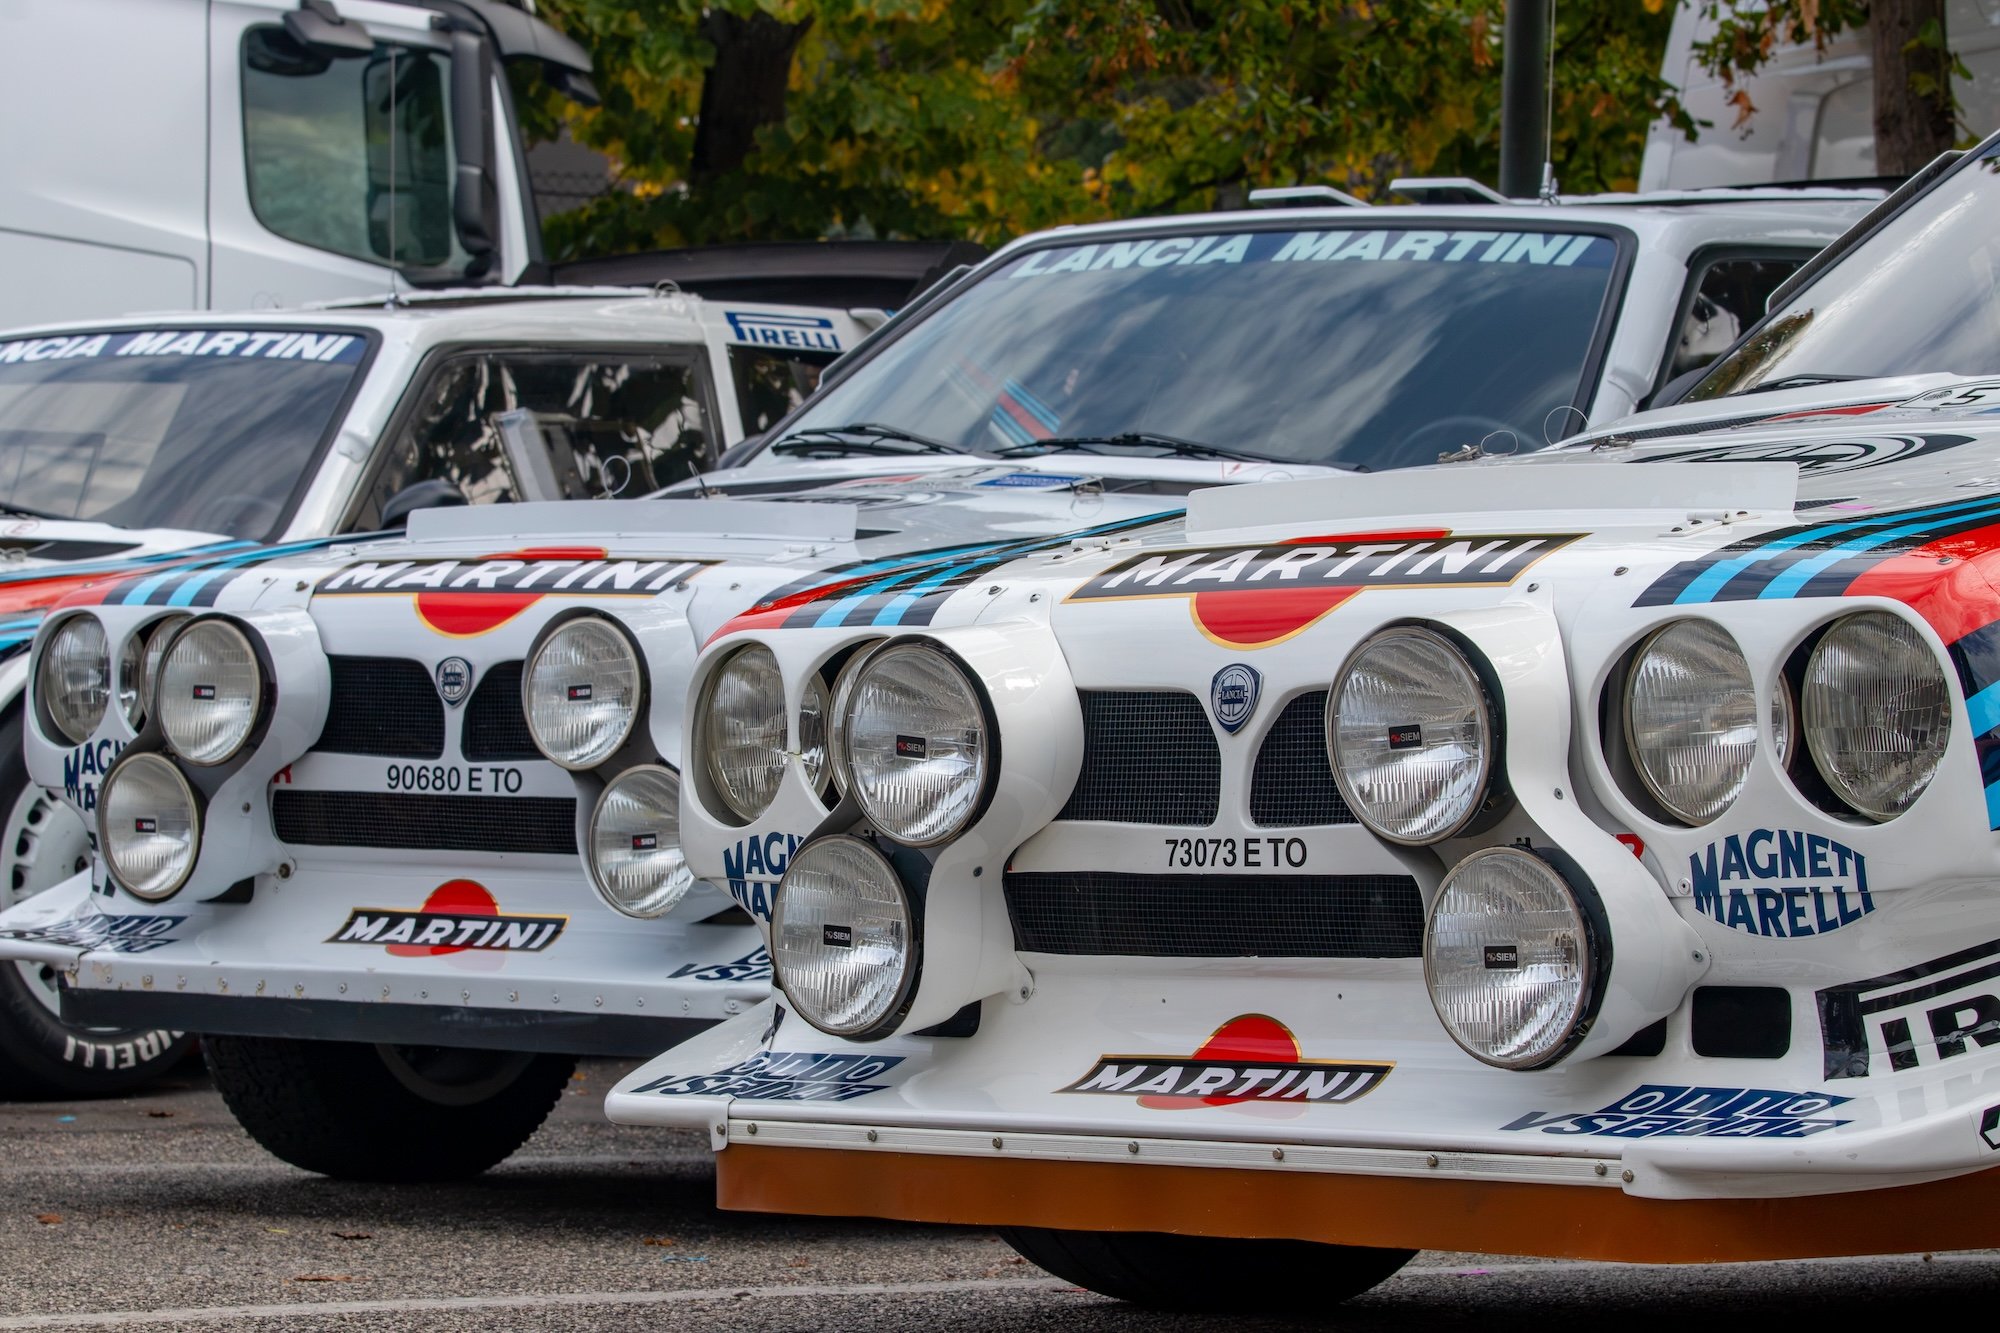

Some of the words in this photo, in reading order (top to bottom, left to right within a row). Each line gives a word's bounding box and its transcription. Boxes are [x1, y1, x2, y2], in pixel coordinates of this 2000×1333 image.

[1010, 235, 1254, 278] LANCIA
[1275, 231, 1596, 267] MARTINI
[117, 331, 355, 361] MARTINI
[725, 312, 841, 350] PIRELLI
[325, 560, 700, 589] MARTINI
[1101, 539, 1547, 588] MARTINI
[1222, 689, 1245, 700] LANCIA
[906, 742, 925, 753] SIEM
[1400, 732, 1421, 742] SIEM
[387, 764, 461, 792] 90680
[468, 767, 482, 792] E
[490, 767, 522, 794] TO
[1165, 838, 1237, 868] 73073
[1244, 838, 1261, 867] E
[1267, 837, 1307, 868] TO
[1689, 828, 1868, 896] MAGNETI
[1695, 885, 1876, 938] MARELLI
[338, 916, 557, 949] MARTINI
[833, 931, 850, 942] SIEM
[1496, 952, 1516, 962] SIEM
[1075, 1064, 1375, 1100] MARTINI
[1612, 1089, 1836, 1116] OLIO
